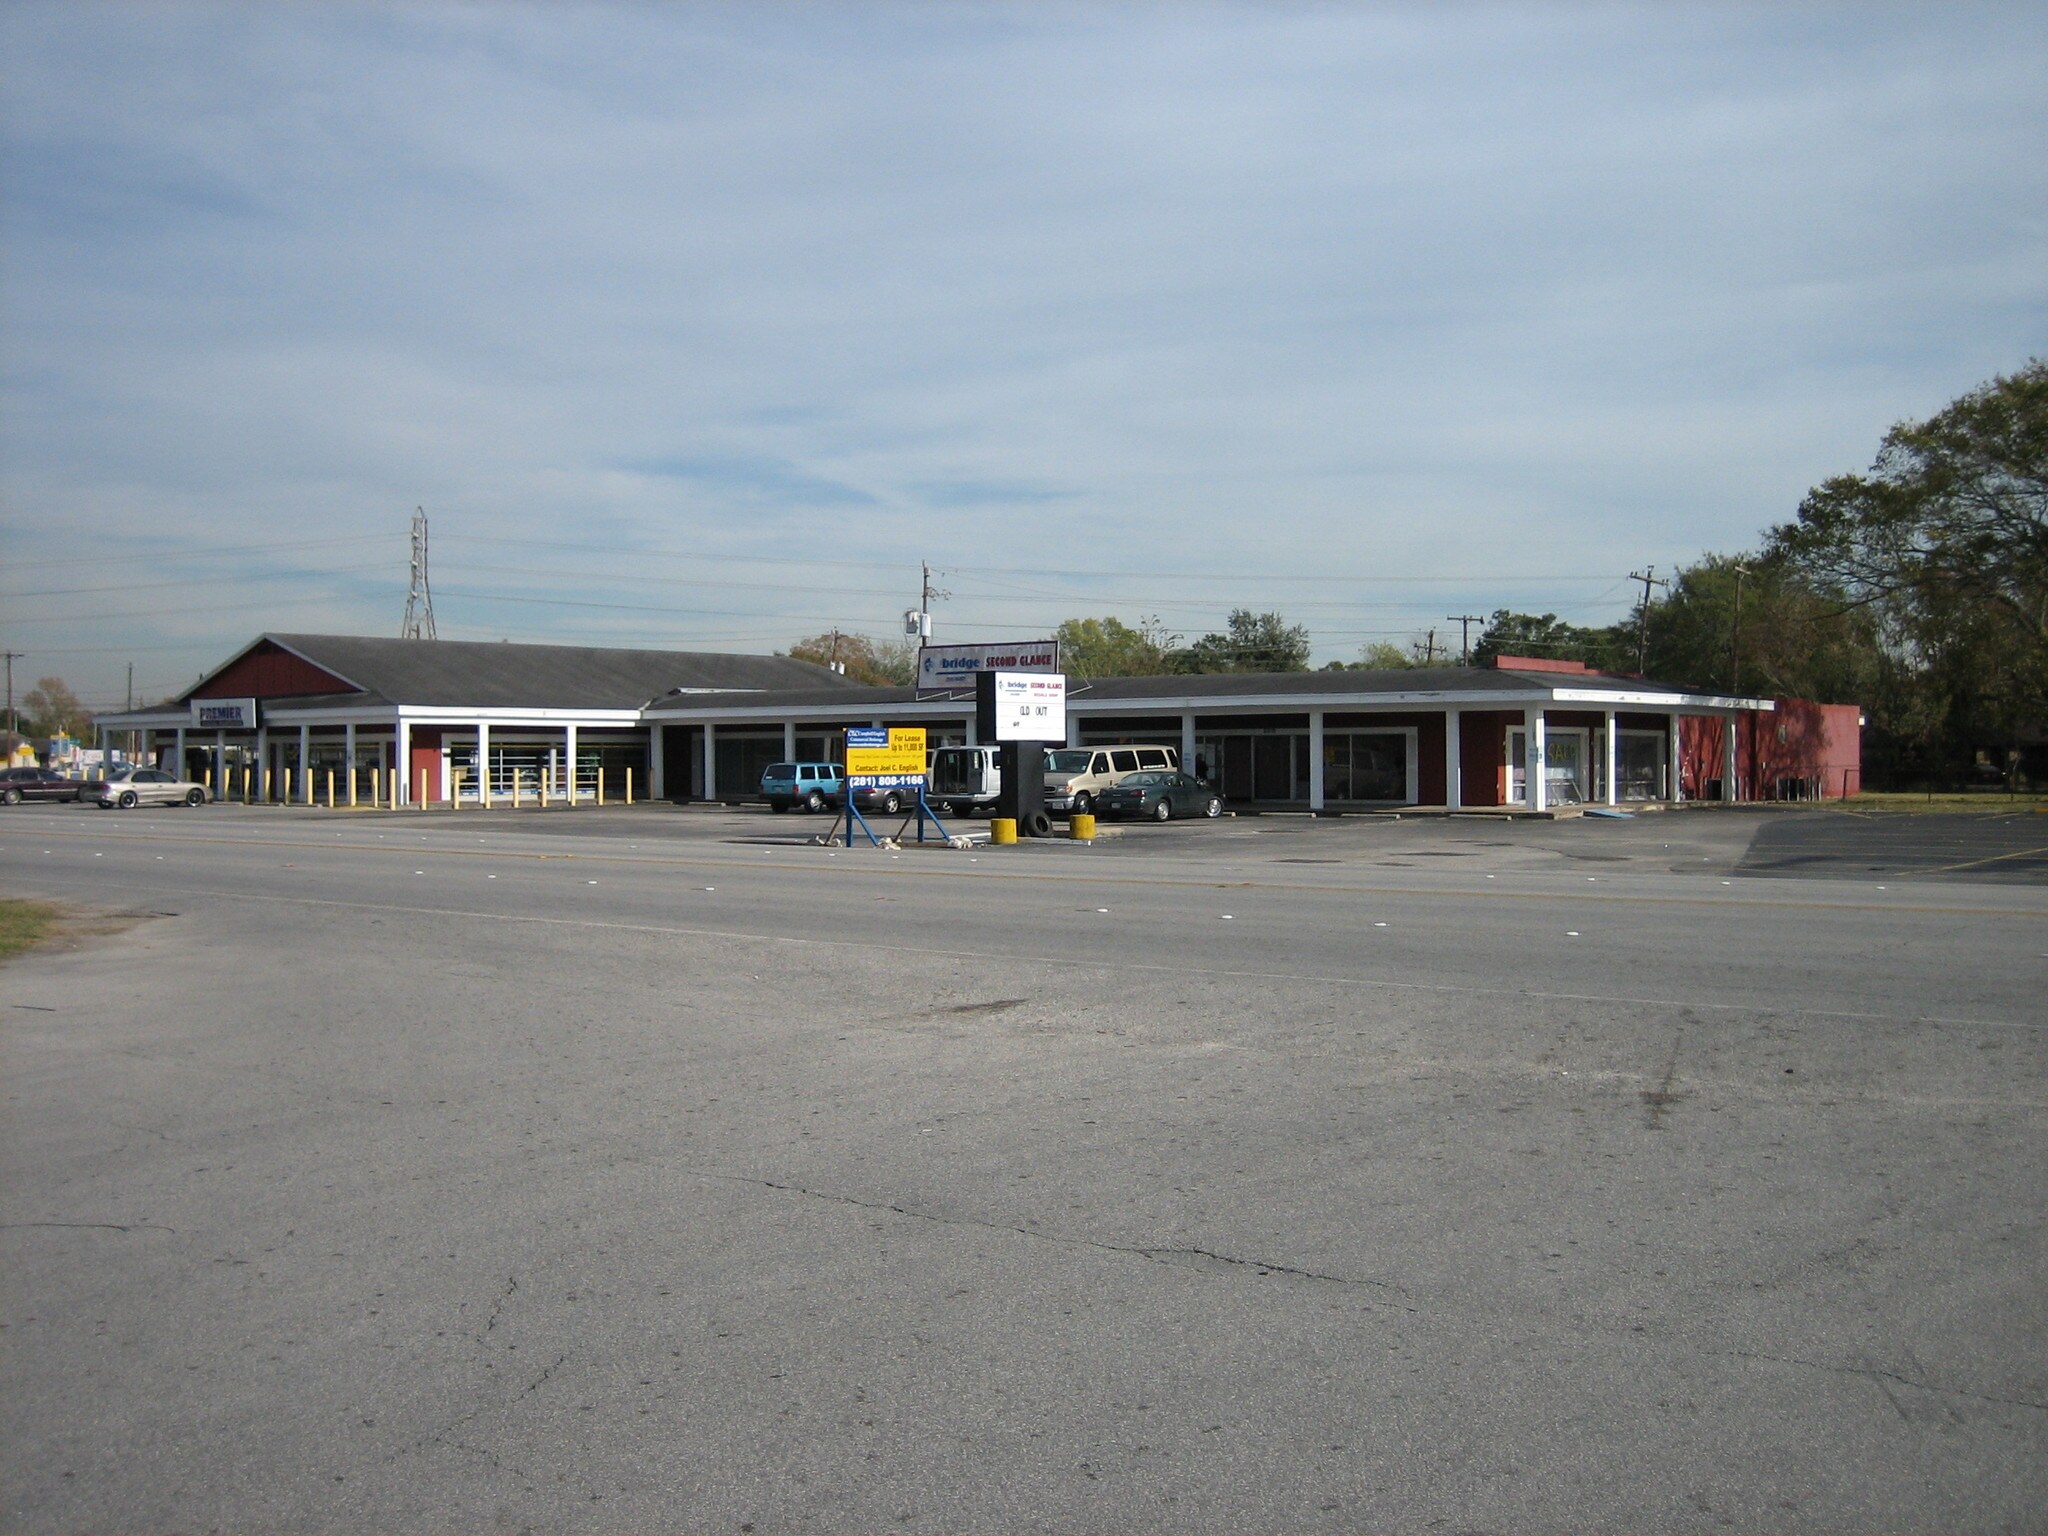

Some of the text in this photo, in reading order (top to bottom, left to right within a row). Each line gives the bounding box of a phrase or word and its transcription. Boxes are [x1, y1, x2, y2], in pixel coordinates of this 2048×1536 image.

[942, 654, 1052, 669] bridge SECOND GLANCE
[1007, 681, 1027, 689] bridge
[200, 706, 242, 720] PREMIER
[1035, 705, 1048, 716] OUT
[894, 734, 921, 742] For Lease
[855, 764, 879, 772] Contact:
[880, 764, 891, 772] Joel
[899, 764, 919, 773] English
[849, 775, 924, 788] (281) 808-1166
